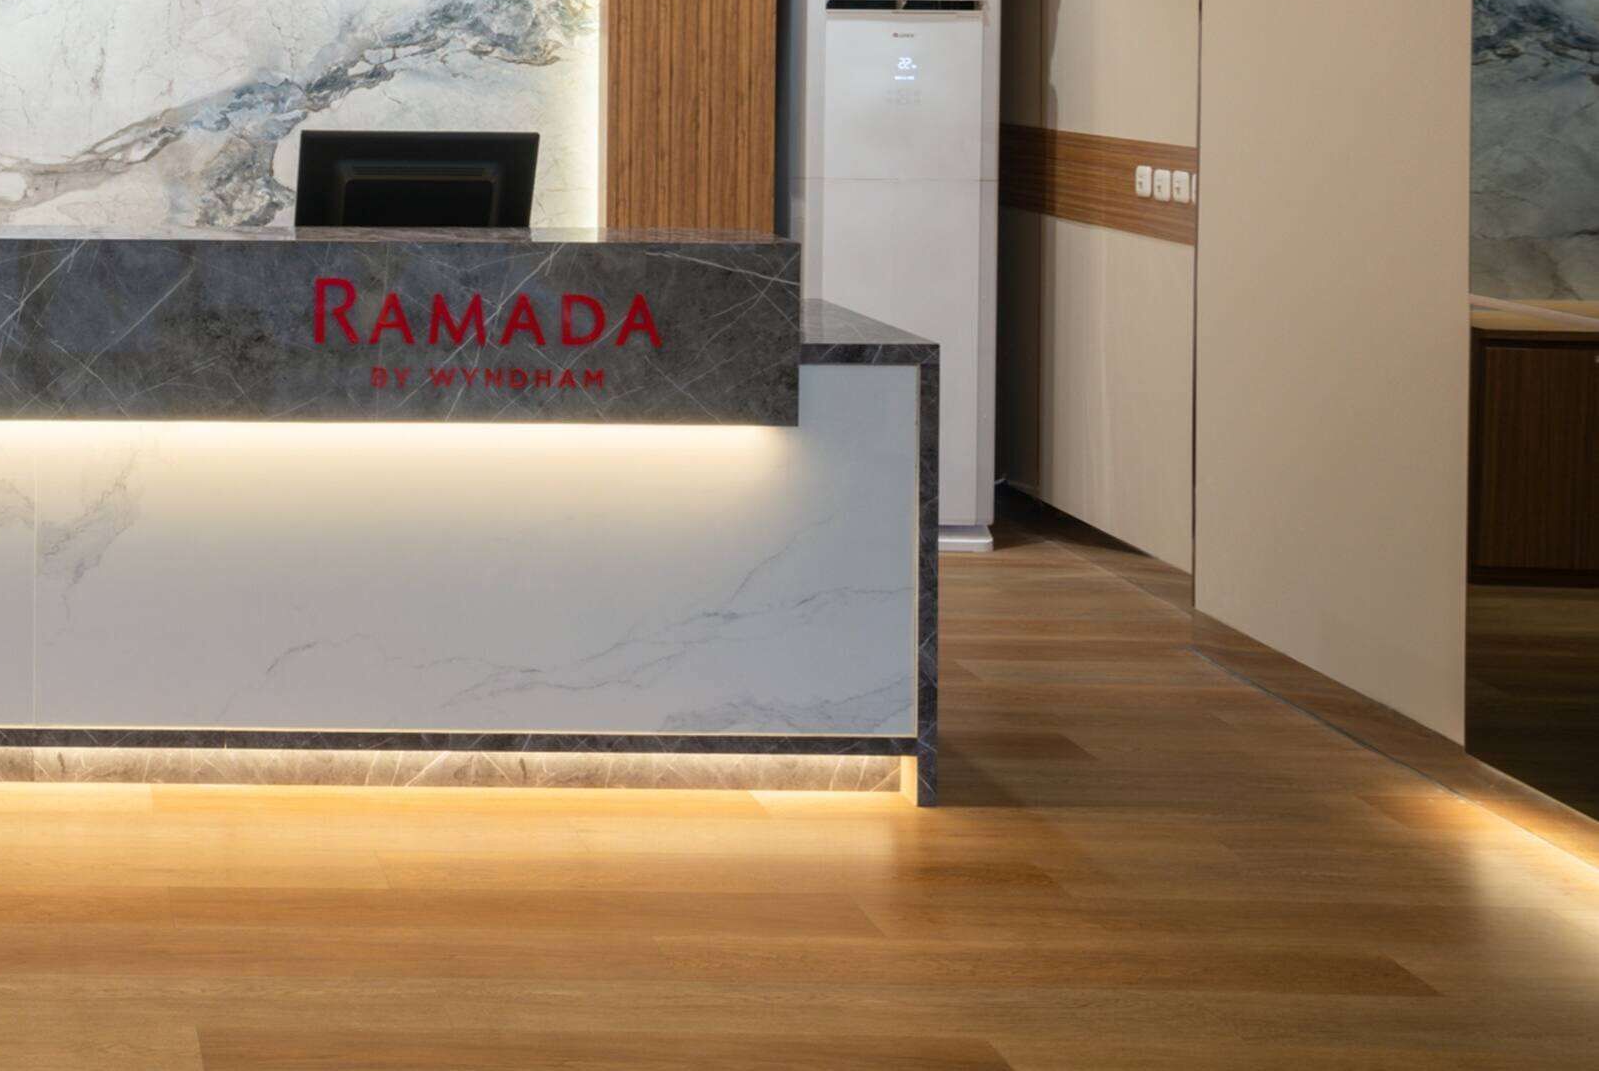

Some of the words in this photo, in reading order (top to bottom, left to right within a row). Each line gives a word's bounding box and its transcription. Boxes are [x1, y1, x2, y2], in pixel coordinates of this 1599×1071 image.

[313, 276, 663, 348] RAMADA
[370, 366, 410, 389] BY
[430, 366, 606, 389] WYNDHAM
